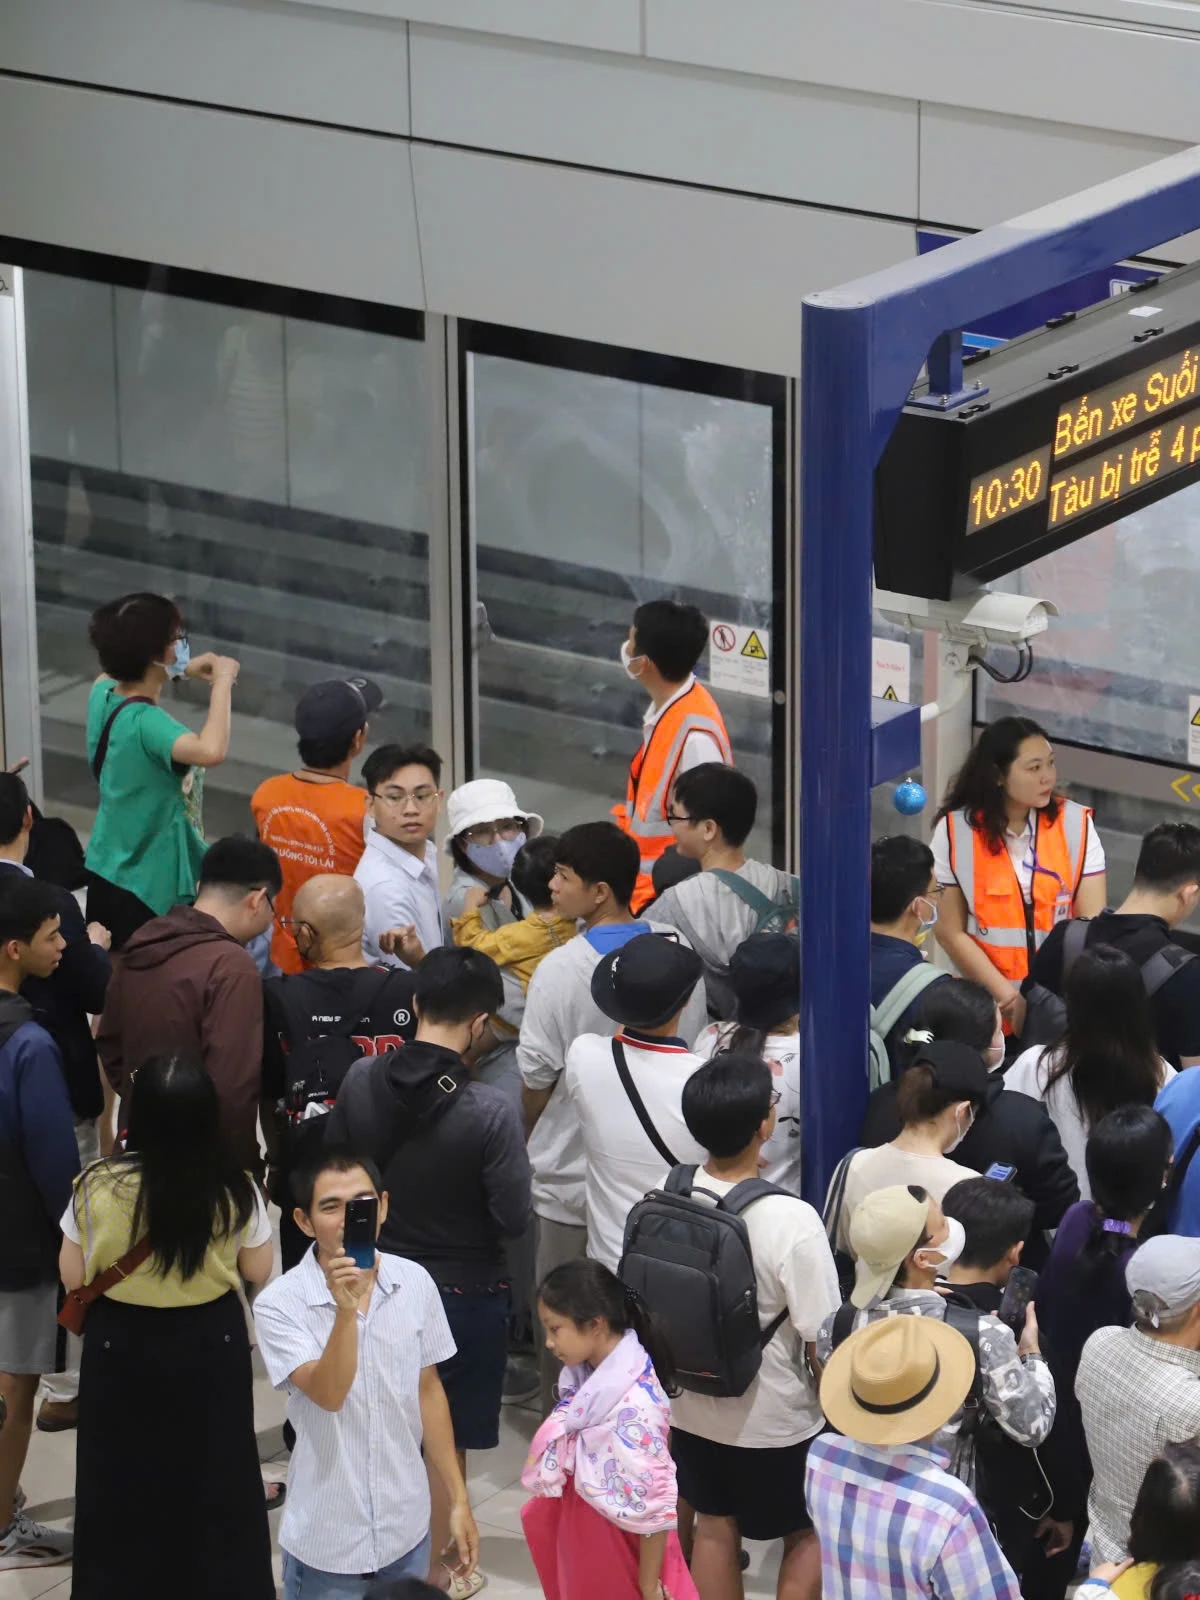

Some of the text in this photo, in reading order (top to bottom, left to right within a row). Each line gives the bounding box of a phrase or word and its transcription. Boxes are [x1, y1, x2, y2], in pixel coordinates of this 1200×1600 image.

[1054, 396, 1103, 455] Bến
[1108, 392, 1138, 431] xe
[1144, 350, 1199, 412] Suối
[972, 460, 1041, 525] 10:30
[1049, 476, 1095, 522] Tàu
[1100, 454, 1123, 504] bị
[1129, 430, 1162, 485] trễ
[1170, 425, 1185, 463] 4
